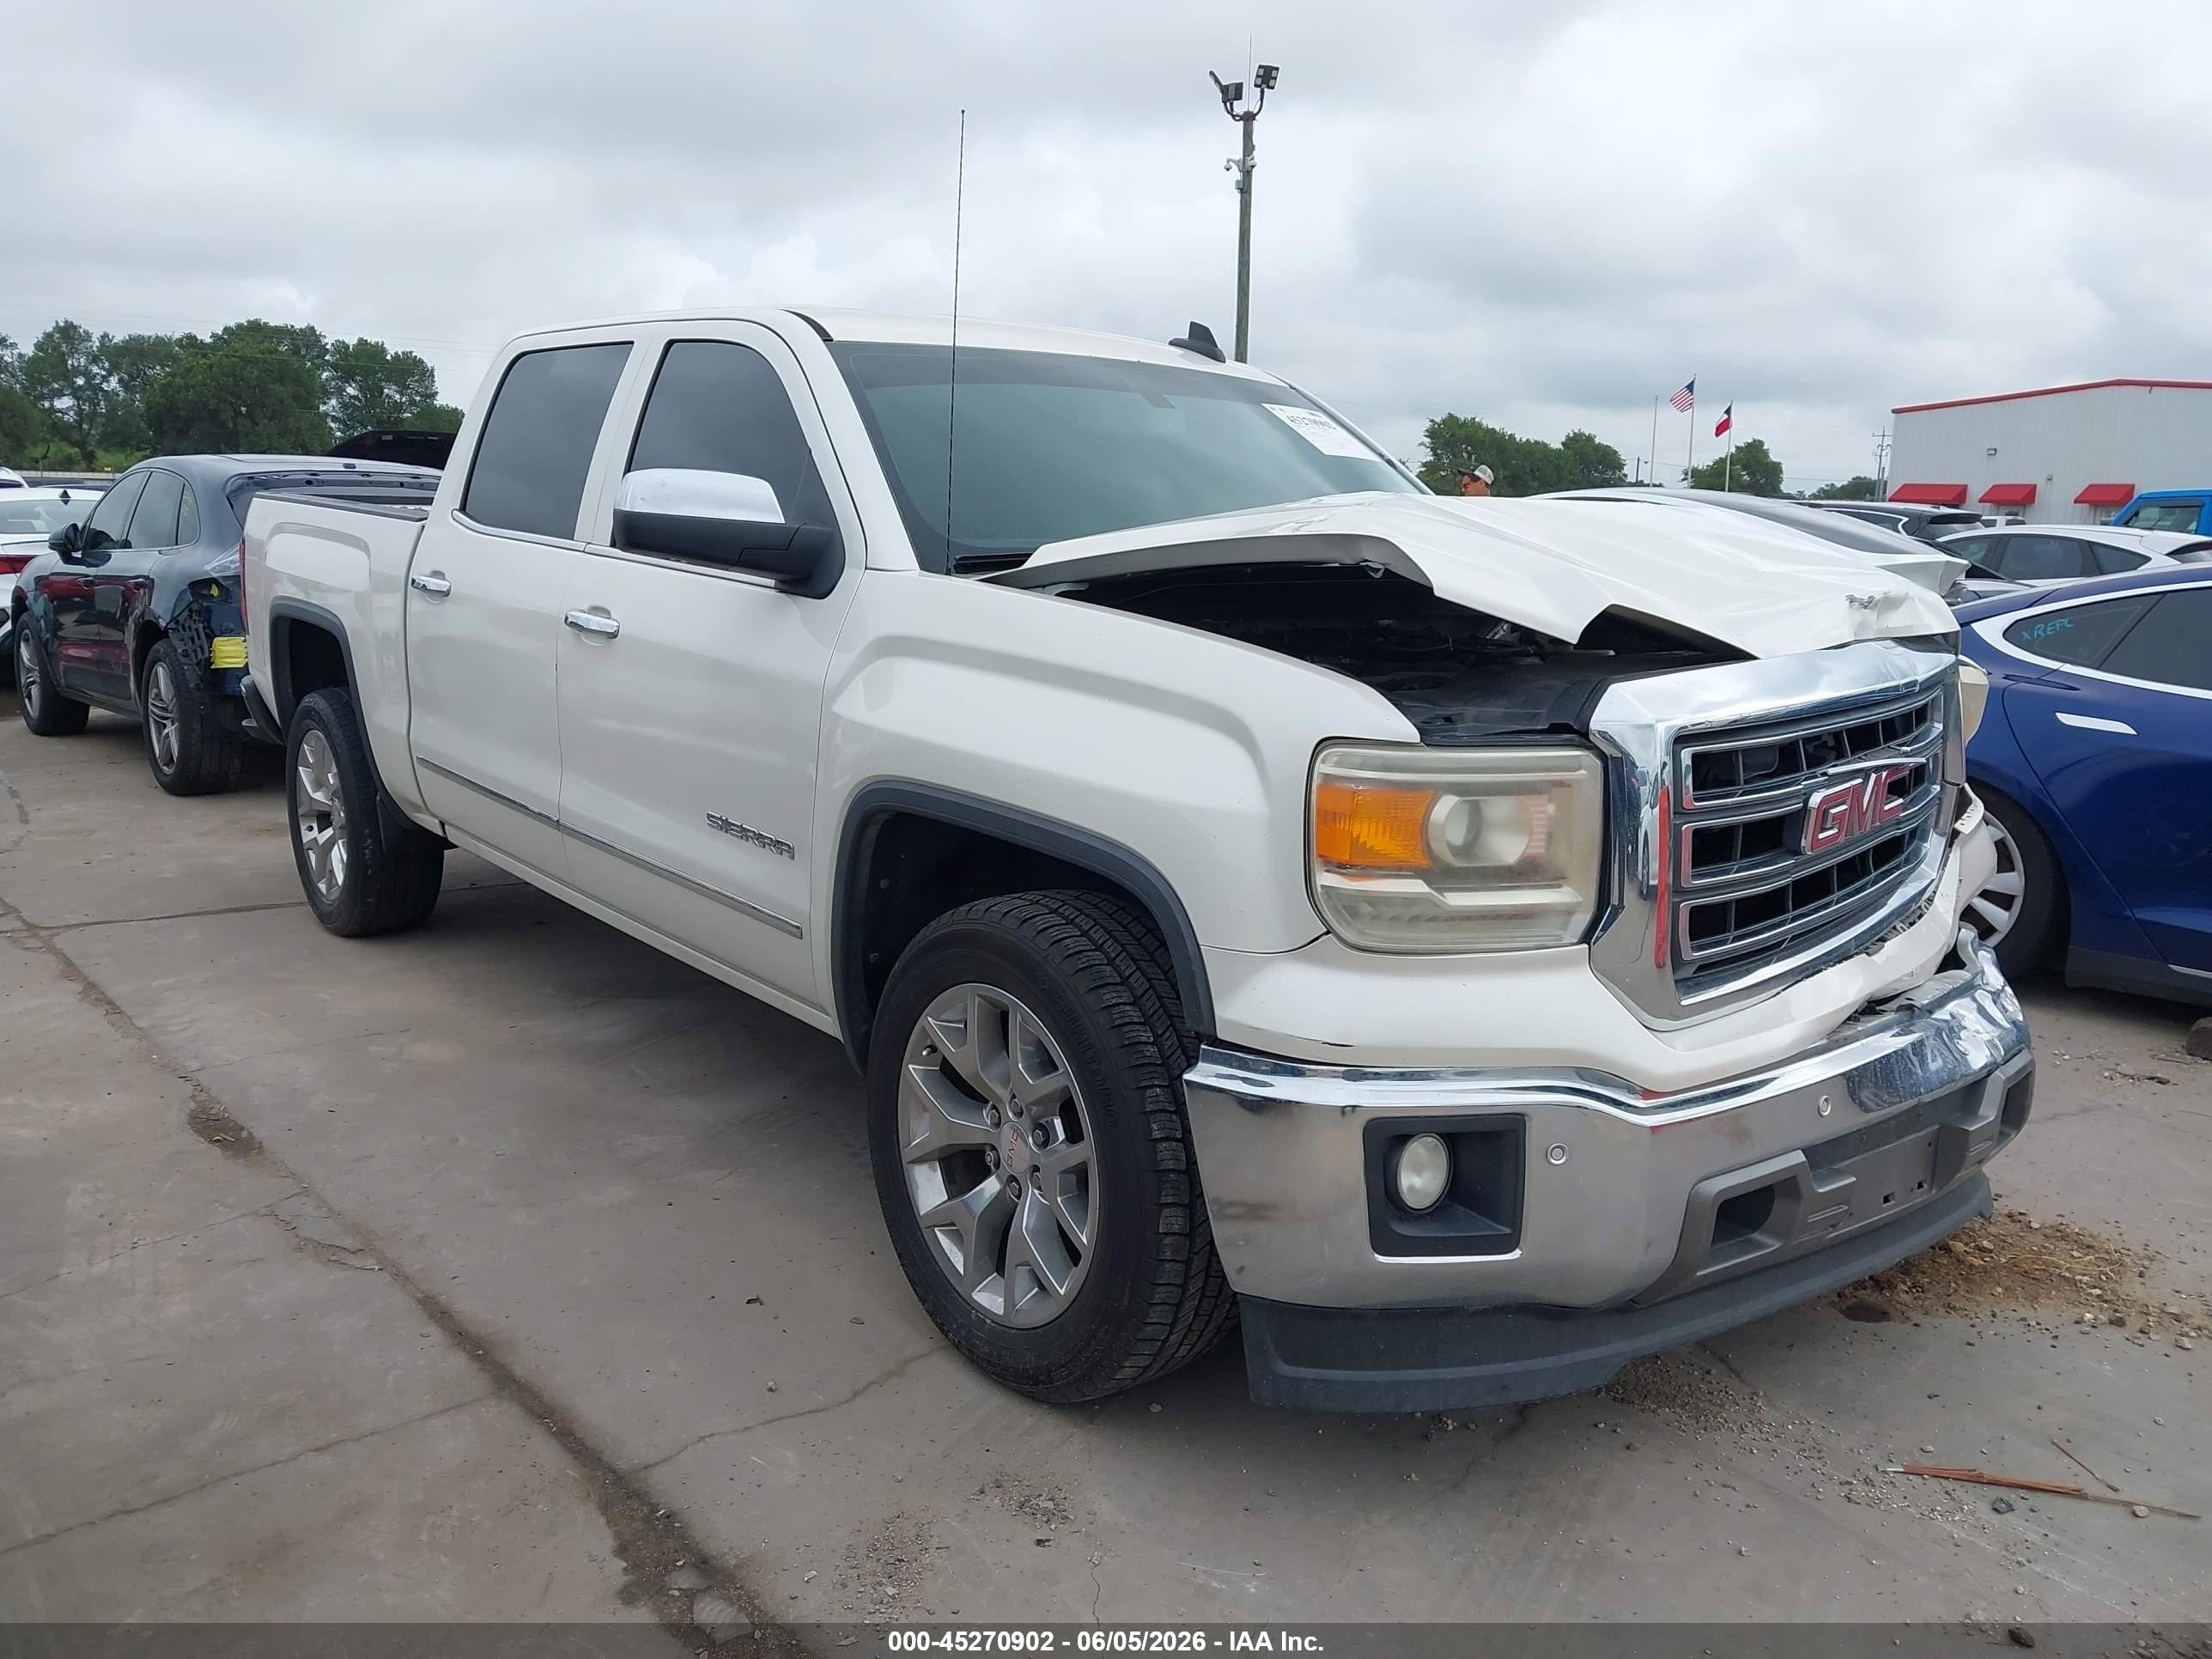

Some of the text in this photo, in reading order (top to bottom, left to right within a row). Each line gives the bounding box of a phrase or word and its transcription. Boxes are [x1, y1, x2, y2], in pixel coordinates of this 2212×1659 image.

[1802, 765, 1911, 854] GMC
[706, 810, 795, 860] SIERRA
[1006, 1127, 1020, 1169] GMC
